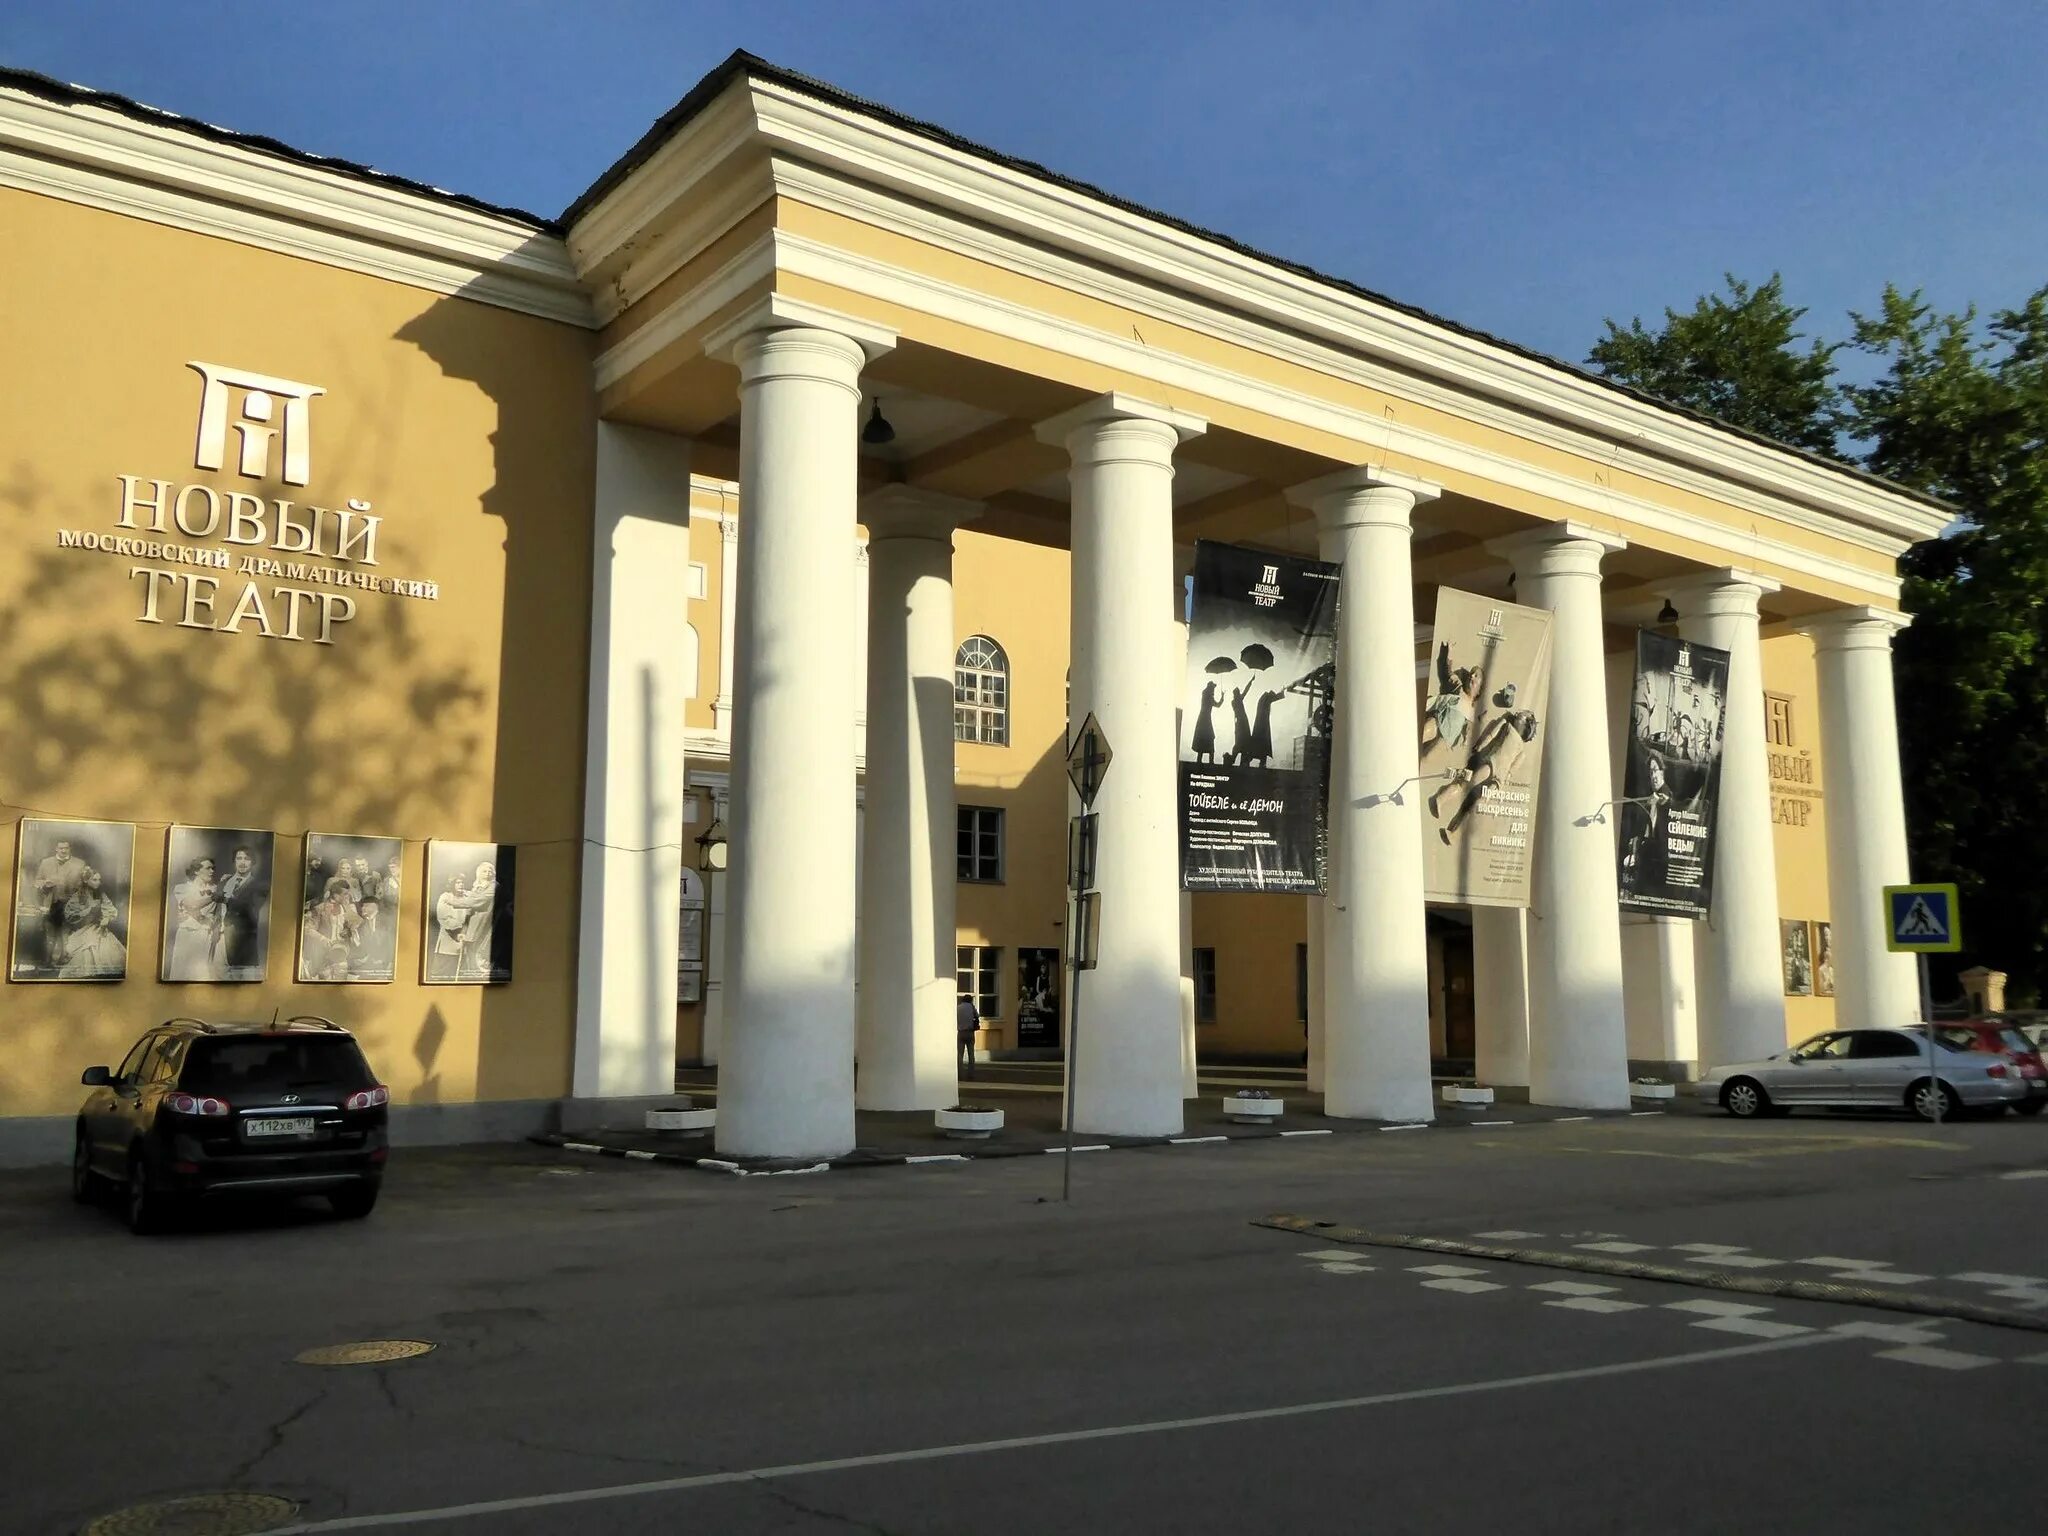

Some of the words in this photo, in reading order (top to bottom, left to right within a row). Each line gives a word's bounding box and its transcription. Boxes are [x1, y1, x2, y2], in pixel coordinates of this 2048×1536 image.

[114, 473, 383, 565] НОВЫЙ
[57, 528, 231, 570] МОСКОВСКИЙ
[237, 555, 440, 600] ДРАМАТИЧЕСКИЙ
[1255, 583, 1280, 596] НОВЫЙ
[1255, 596, 1276, 607] ТЕАТР
[129, 566, 356, 645] ТЕАТР
[1768, 750, 1813, 784] ВЫЙ
[1189, 792, 1230, 810] ТОЙБЕЛЕ
[1247, 798, 1284, 816] ДЕМОН
[1481, 785, 1531, 803] Прекрасное
